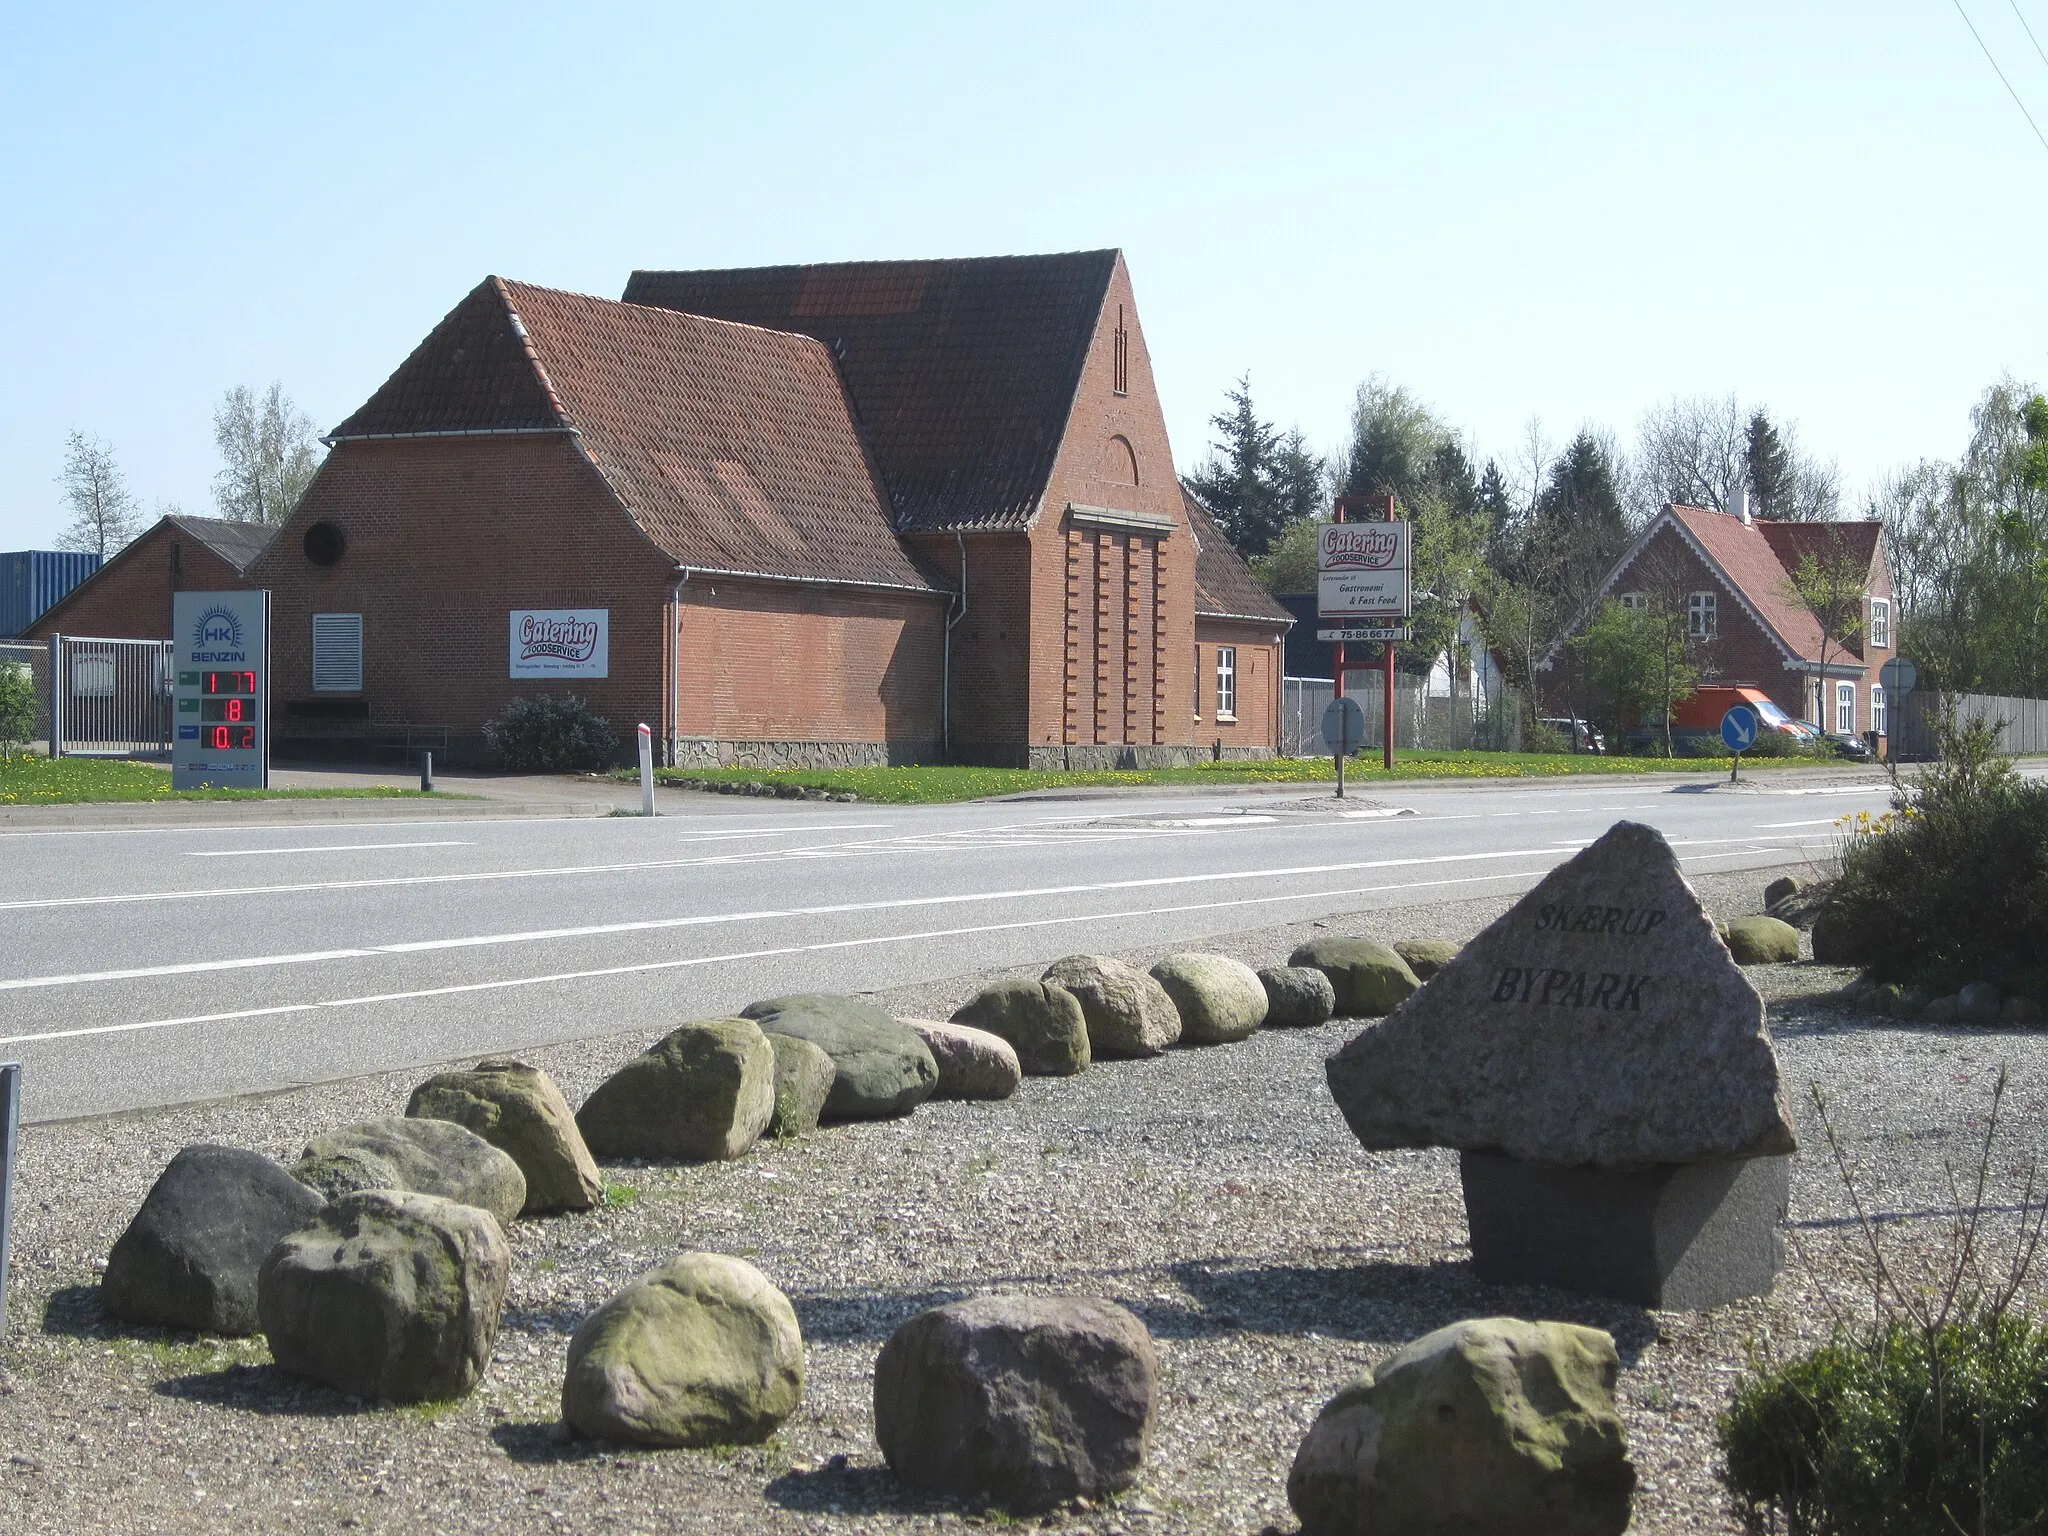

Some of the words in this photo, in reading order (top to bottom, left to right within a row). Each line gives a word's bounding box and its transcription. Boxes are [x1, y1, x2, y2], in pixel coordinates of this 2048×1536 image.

[1323, 528, 1398, 557] Catering
[1332, 553, 1379, 565] FOODSERVICE
[1339, 584, 1384, 592] Gastronomi
[1349, 596, 1356, 605] &
[1358, 596, 1376, 605] Fast
[1377, 596, 1397, 604] Food
[204, 628, 232, 641] HK
[518, 615, 598, 654] Catering
[191, 652, 246, 662] BENZIN
[527, 644, 580, 658] FOODSERVICE
[1534, 903, 1667, 936] SKÆRUP
[1491, 966, 1651, 1012] BYPARK
